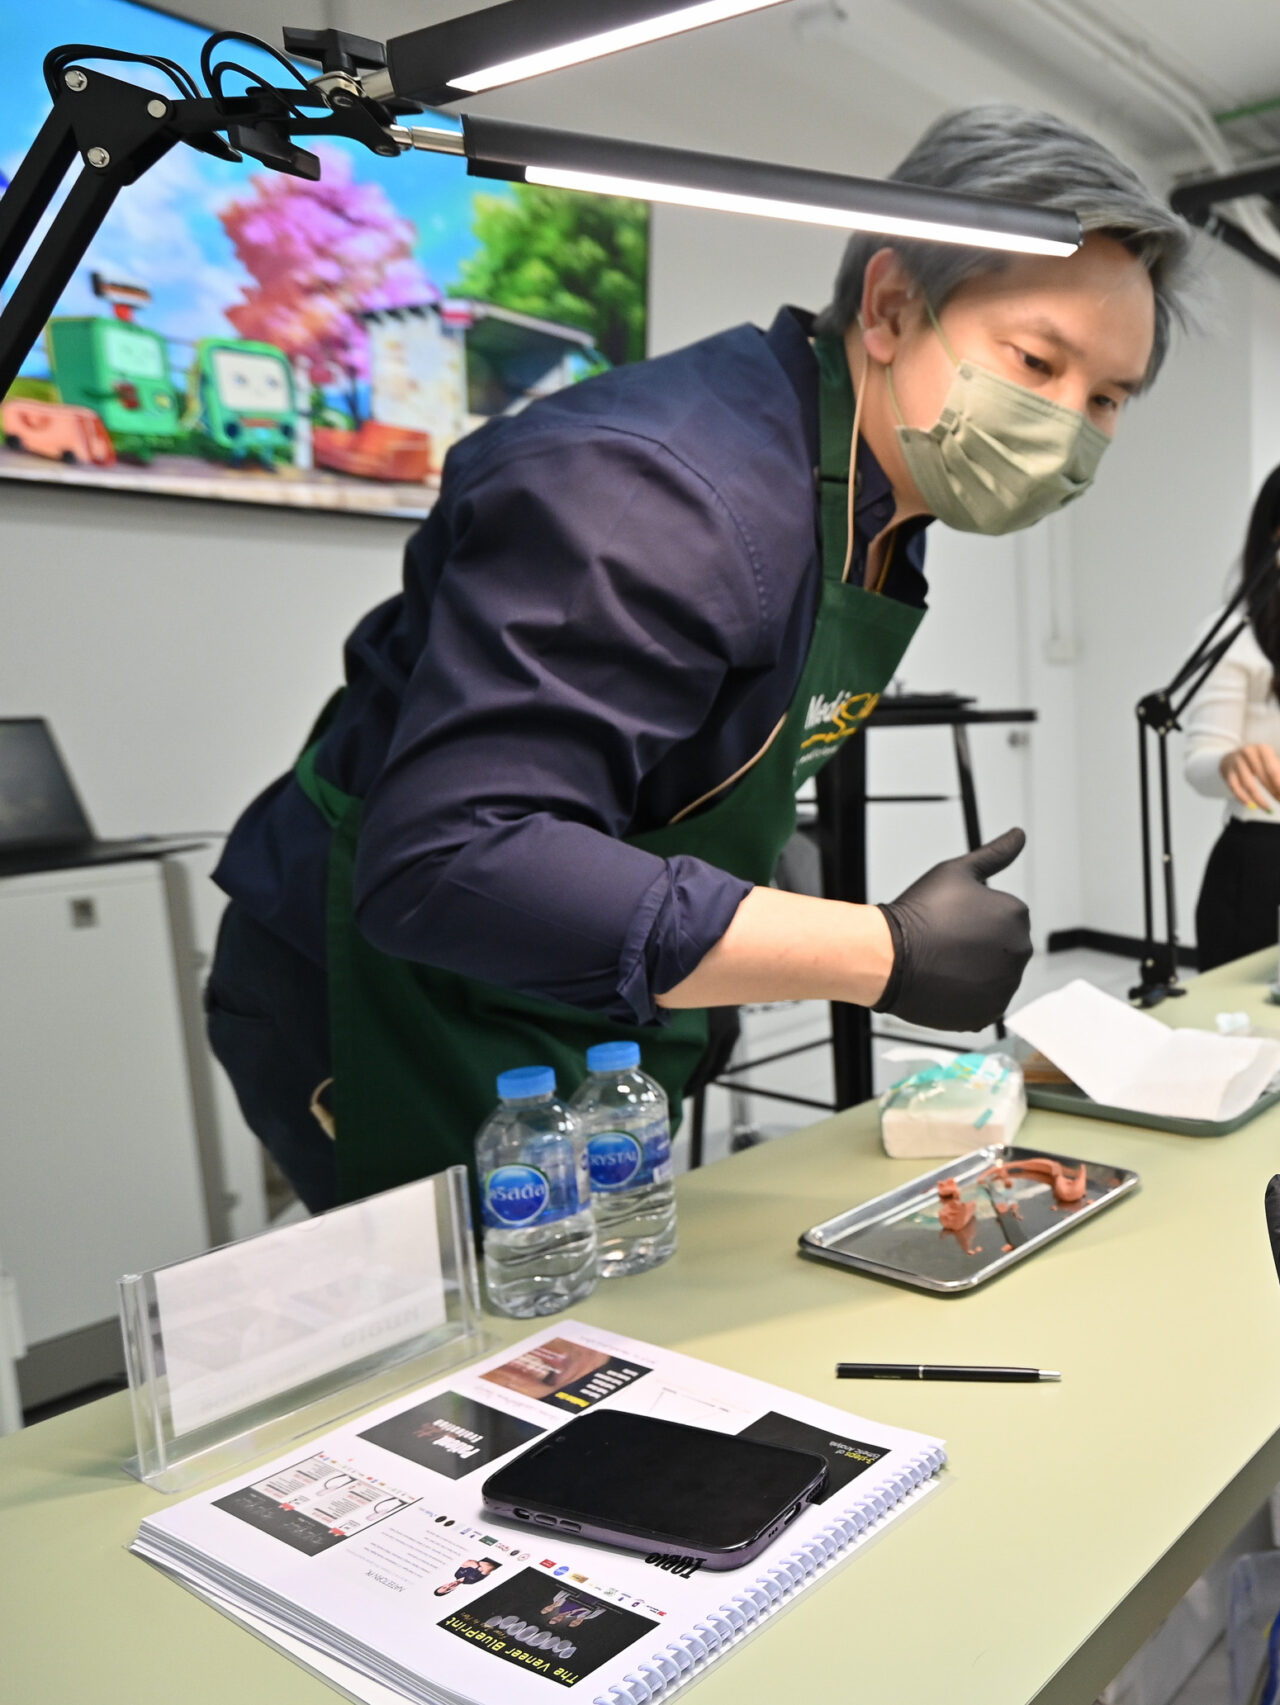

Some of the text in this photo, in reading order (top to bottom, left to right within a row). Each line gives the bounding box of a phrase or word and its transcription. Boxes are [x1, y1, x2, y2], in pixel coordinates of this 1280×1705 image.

[589, 1151, 637, 1166] RYSTAL
[444, 1616, 579, 1685] The Veneer BluePrint
